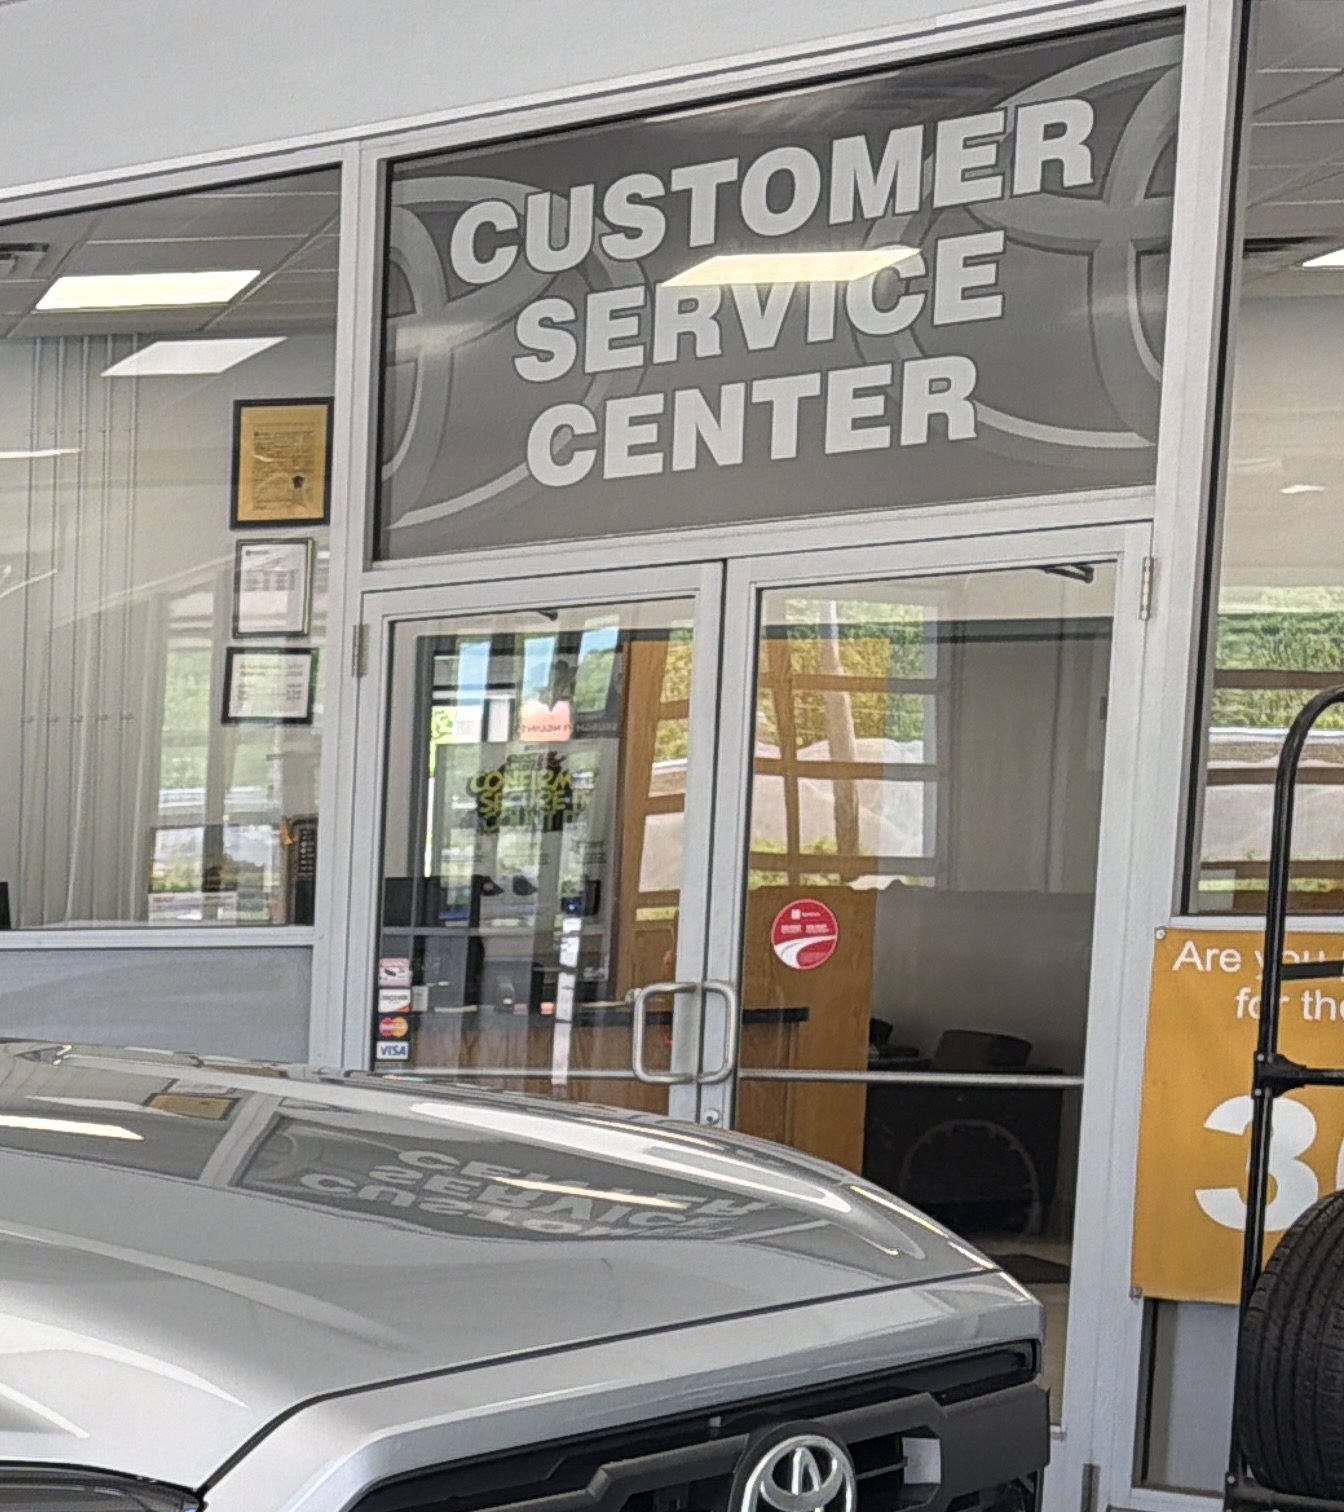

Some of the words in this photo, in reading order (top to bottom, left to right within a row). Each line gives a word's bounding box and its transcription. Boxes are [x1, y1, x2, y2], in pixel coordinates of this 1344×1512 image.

[449, 98, 1097, 286] CUSTOMER
[512, 230, 1006, 383] SERVICE
[526, 356, 980, 489] CENTER
[1172, 940, 1242, 972] Are
[1301, 988, 1344, 1021] th
[380, 1045, 407, 1057] VISA
